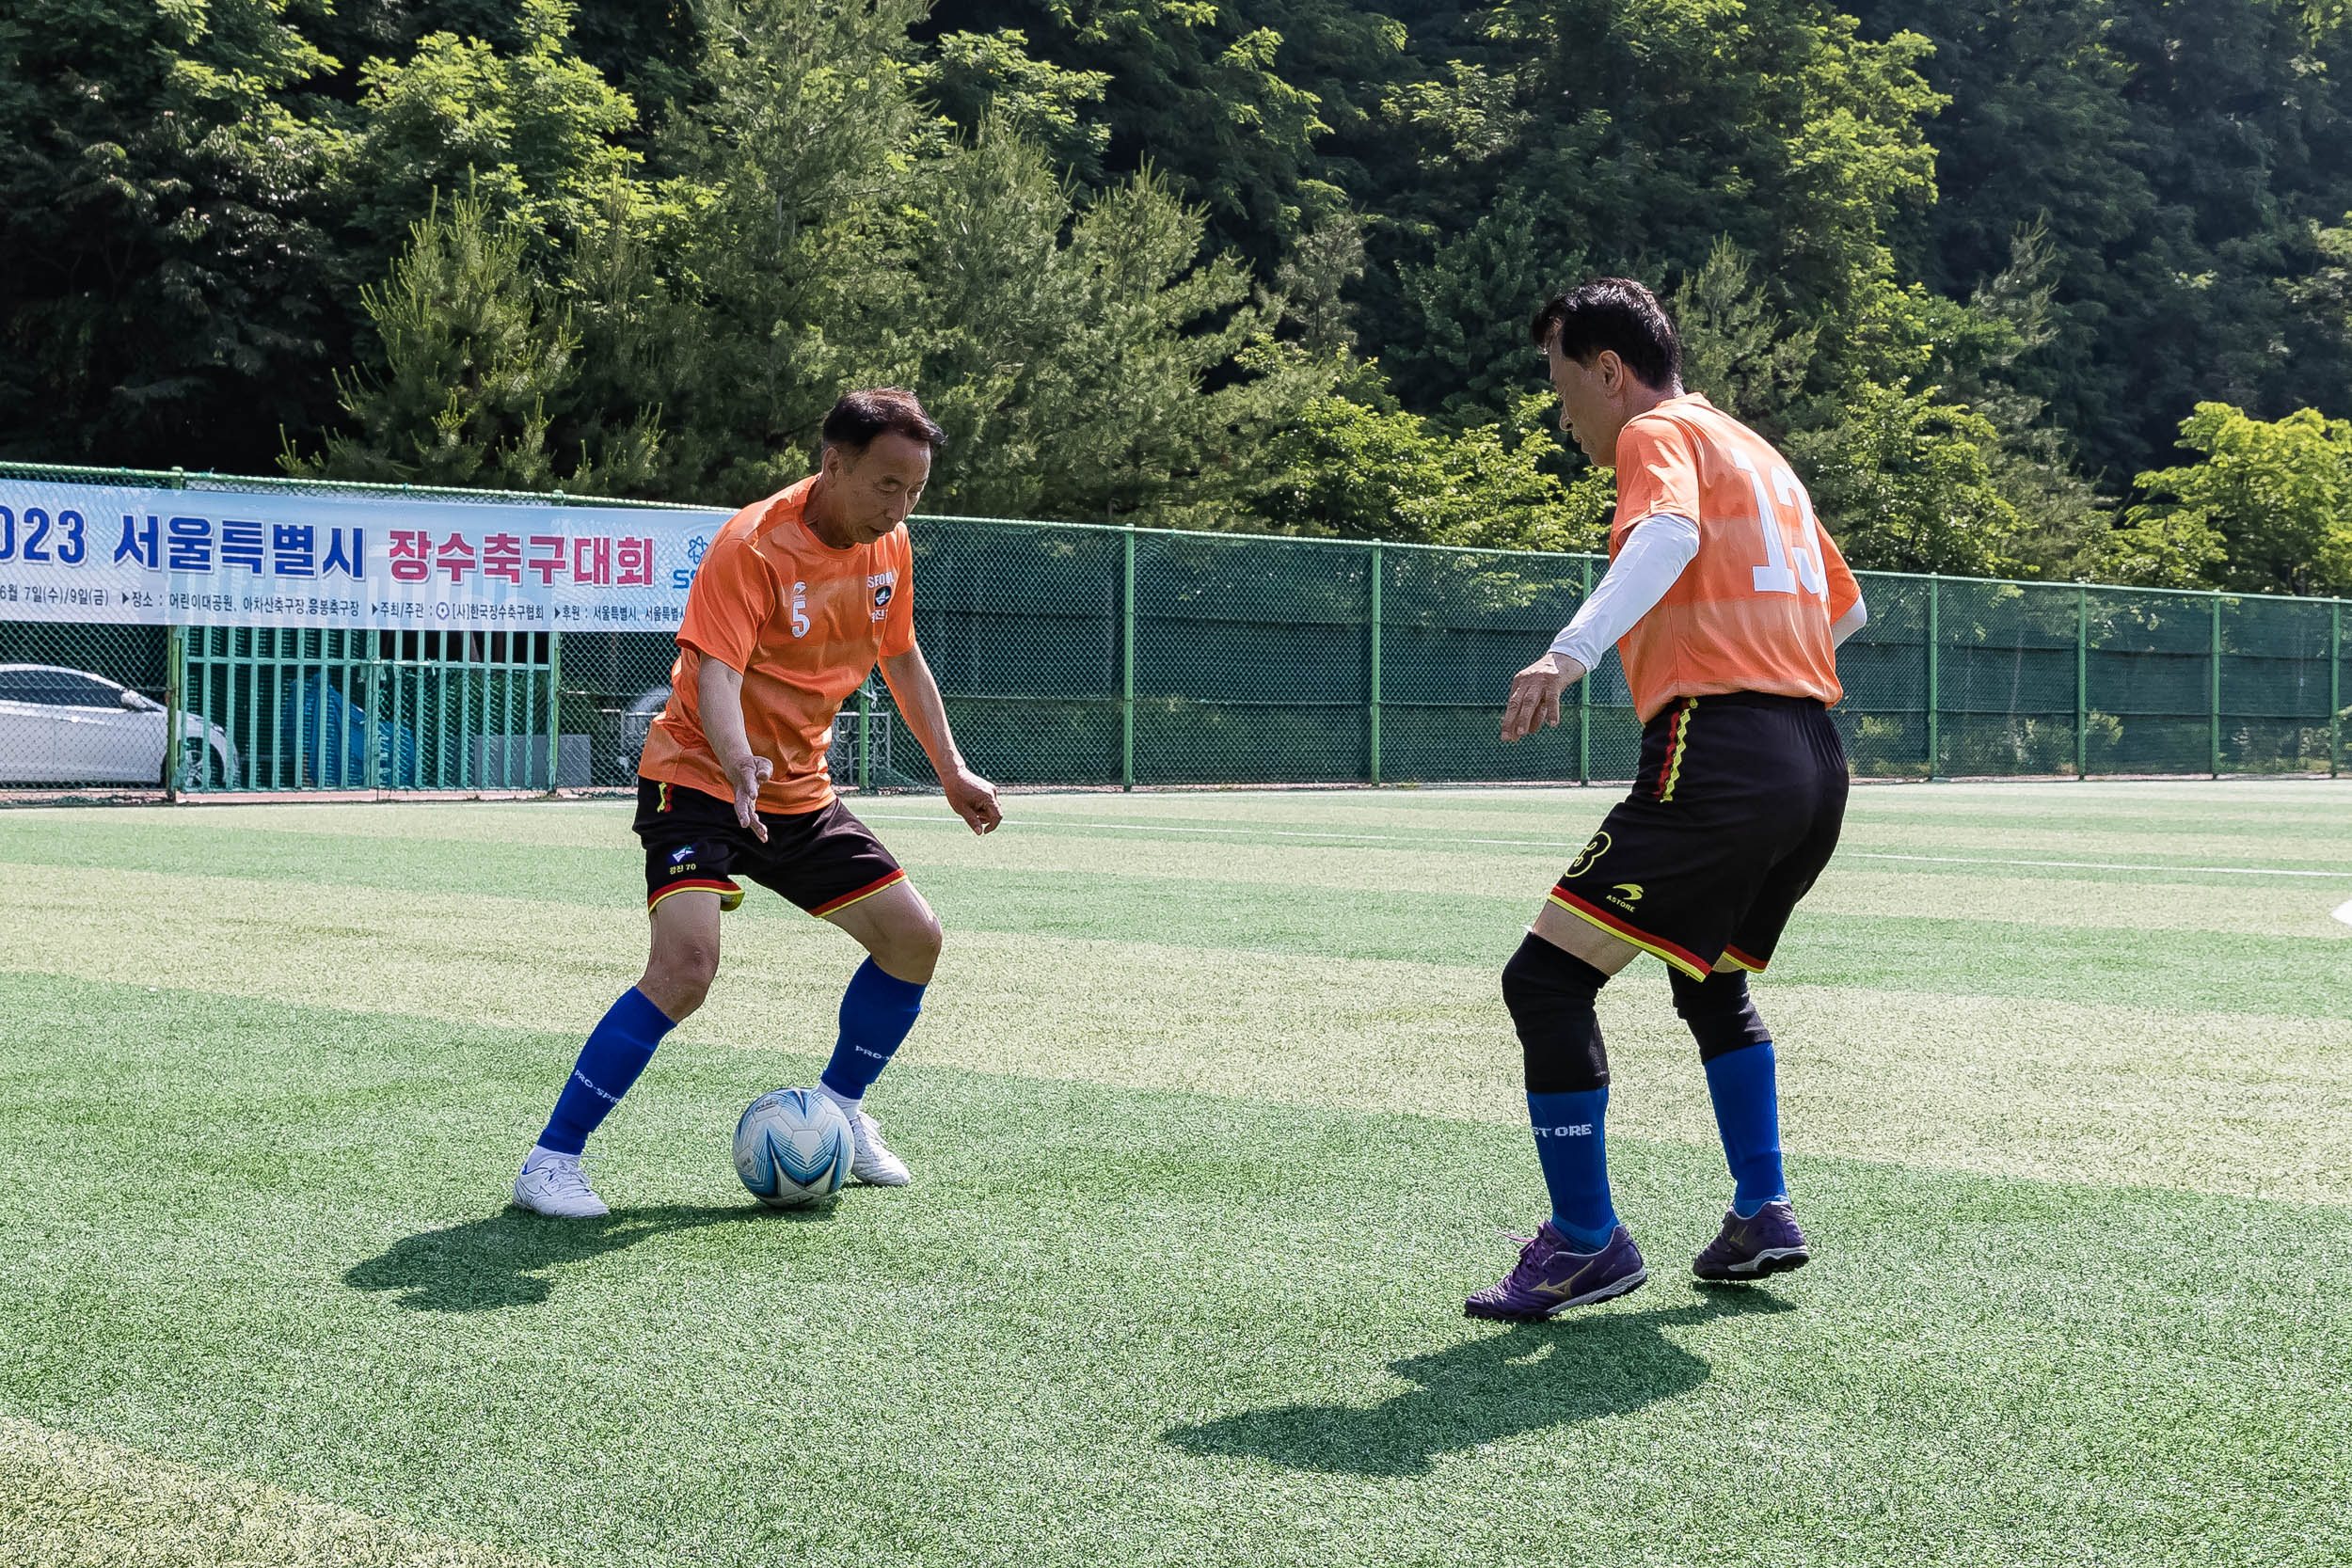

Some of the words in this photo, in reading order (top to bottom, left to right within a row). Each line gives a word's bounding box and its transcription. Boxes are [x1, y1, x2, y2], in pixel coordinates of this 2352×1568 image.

[1730, 448, 1830, 603] 13
[114, 515, 363, 578] 서울특별시
[389, 530, 654, 587] 장수축구대회
[132, 591, 153, 608] 장소
[380, 601, 424, 619] 주최/주관
[562, 604, 580, 621] 후원
[791, 600, 810, 639] 5
[1606, 895, 1635, 912] ASTORE
